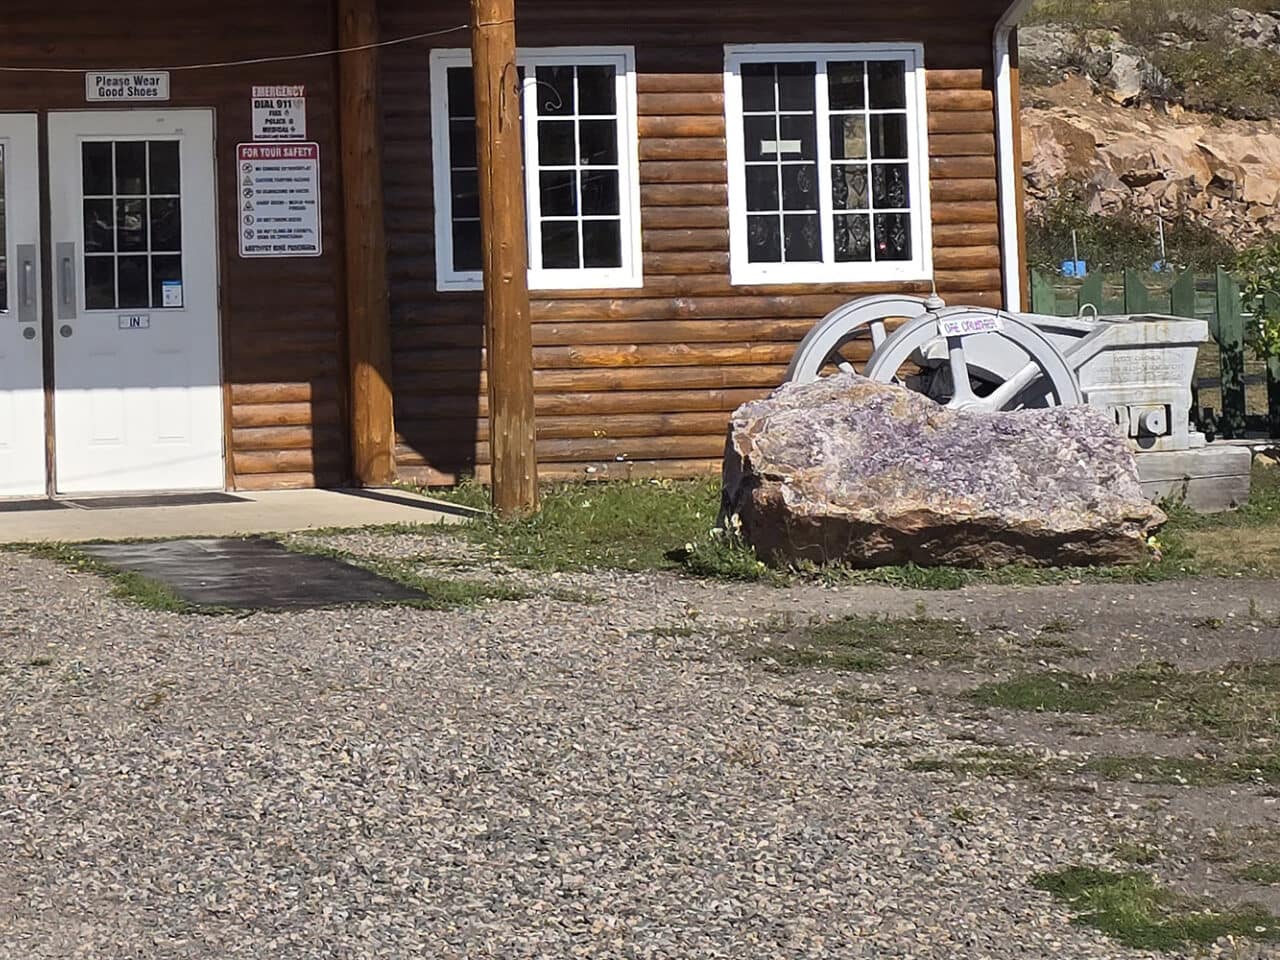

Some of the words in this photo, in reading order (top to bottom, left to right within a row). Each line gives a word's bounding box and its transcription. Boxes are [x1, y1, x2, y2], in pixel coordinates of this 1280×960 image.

[95, 76, 130, 87] Please
[133, 75, 160, 87] Wear
[98, 86, 124, 97] Good
[127, 86, 158, 97] Shoes
[252, 85, 305, 97] EMERGENCY
[254, 100, 274, 109] DIAL
[276, 100, 292, 109] 911
[242, 148, 259, 158] FOR
[260, 147, 282, 158] YOUR
[283, 147, 313, 157] SAFETY
[128, 317, 141, 327] IN
